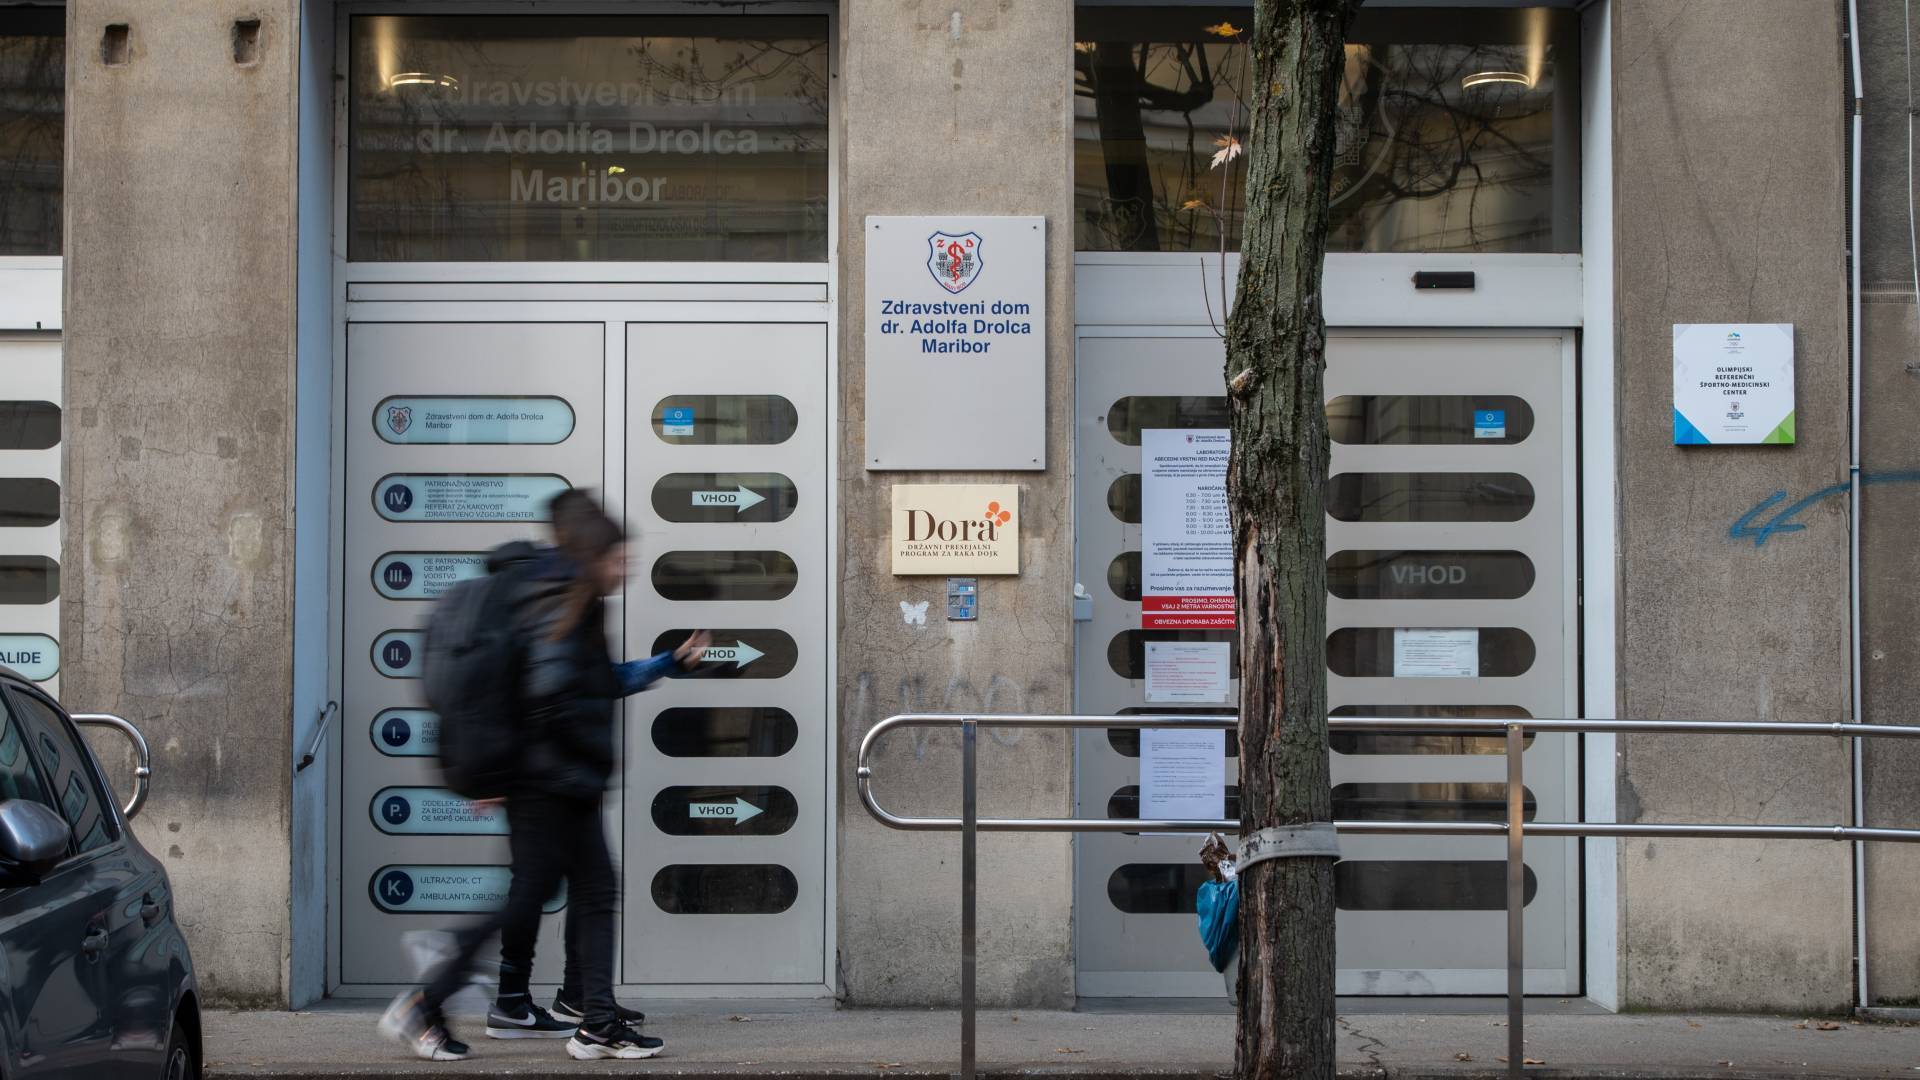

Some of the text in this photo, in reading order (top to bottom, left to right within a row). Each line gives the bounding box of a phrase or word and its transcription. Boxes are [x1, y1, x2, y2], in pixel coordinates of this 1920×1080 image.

[416, 121, 468, 154] dr.
[484, 121, 614, 154] Adolfa
[629, 121, 759, 154] Drolca
[510, 168, 667, 203] Maribor
[881, 300, 1030, 315] Zdravstveni dom
[880, 319, 1031, 334] dr. Adolfa Drolca
[922, 338, 991, 353] Maribor
[425, 412, 544, 421] Zdravstveni dom dr. Adolfa Drolca
[425, 421, 453, 429] Maribor
[424, 479, 471, 487] PATRONAŽNO
[389, 491, 407, 506] IV.
[701, 494, 737, 503] VHOD
[902, 509, 999, 542] Dora
[389, 569, 407, 582] III.
[1391, 565, 1467, 584] VHOD
[390, 647, 404, 661] II.
[700, 649, 736, 659] VHOD
[392, 726, 401, 739] I.
[389, 804, 403, 817] P.
[698, 806, 735, 816] VHOD
[471, 876, 482, 884] CT
[386, 879, 405, 897] K.
[419, 892, 470, 901] AMBULANTA
